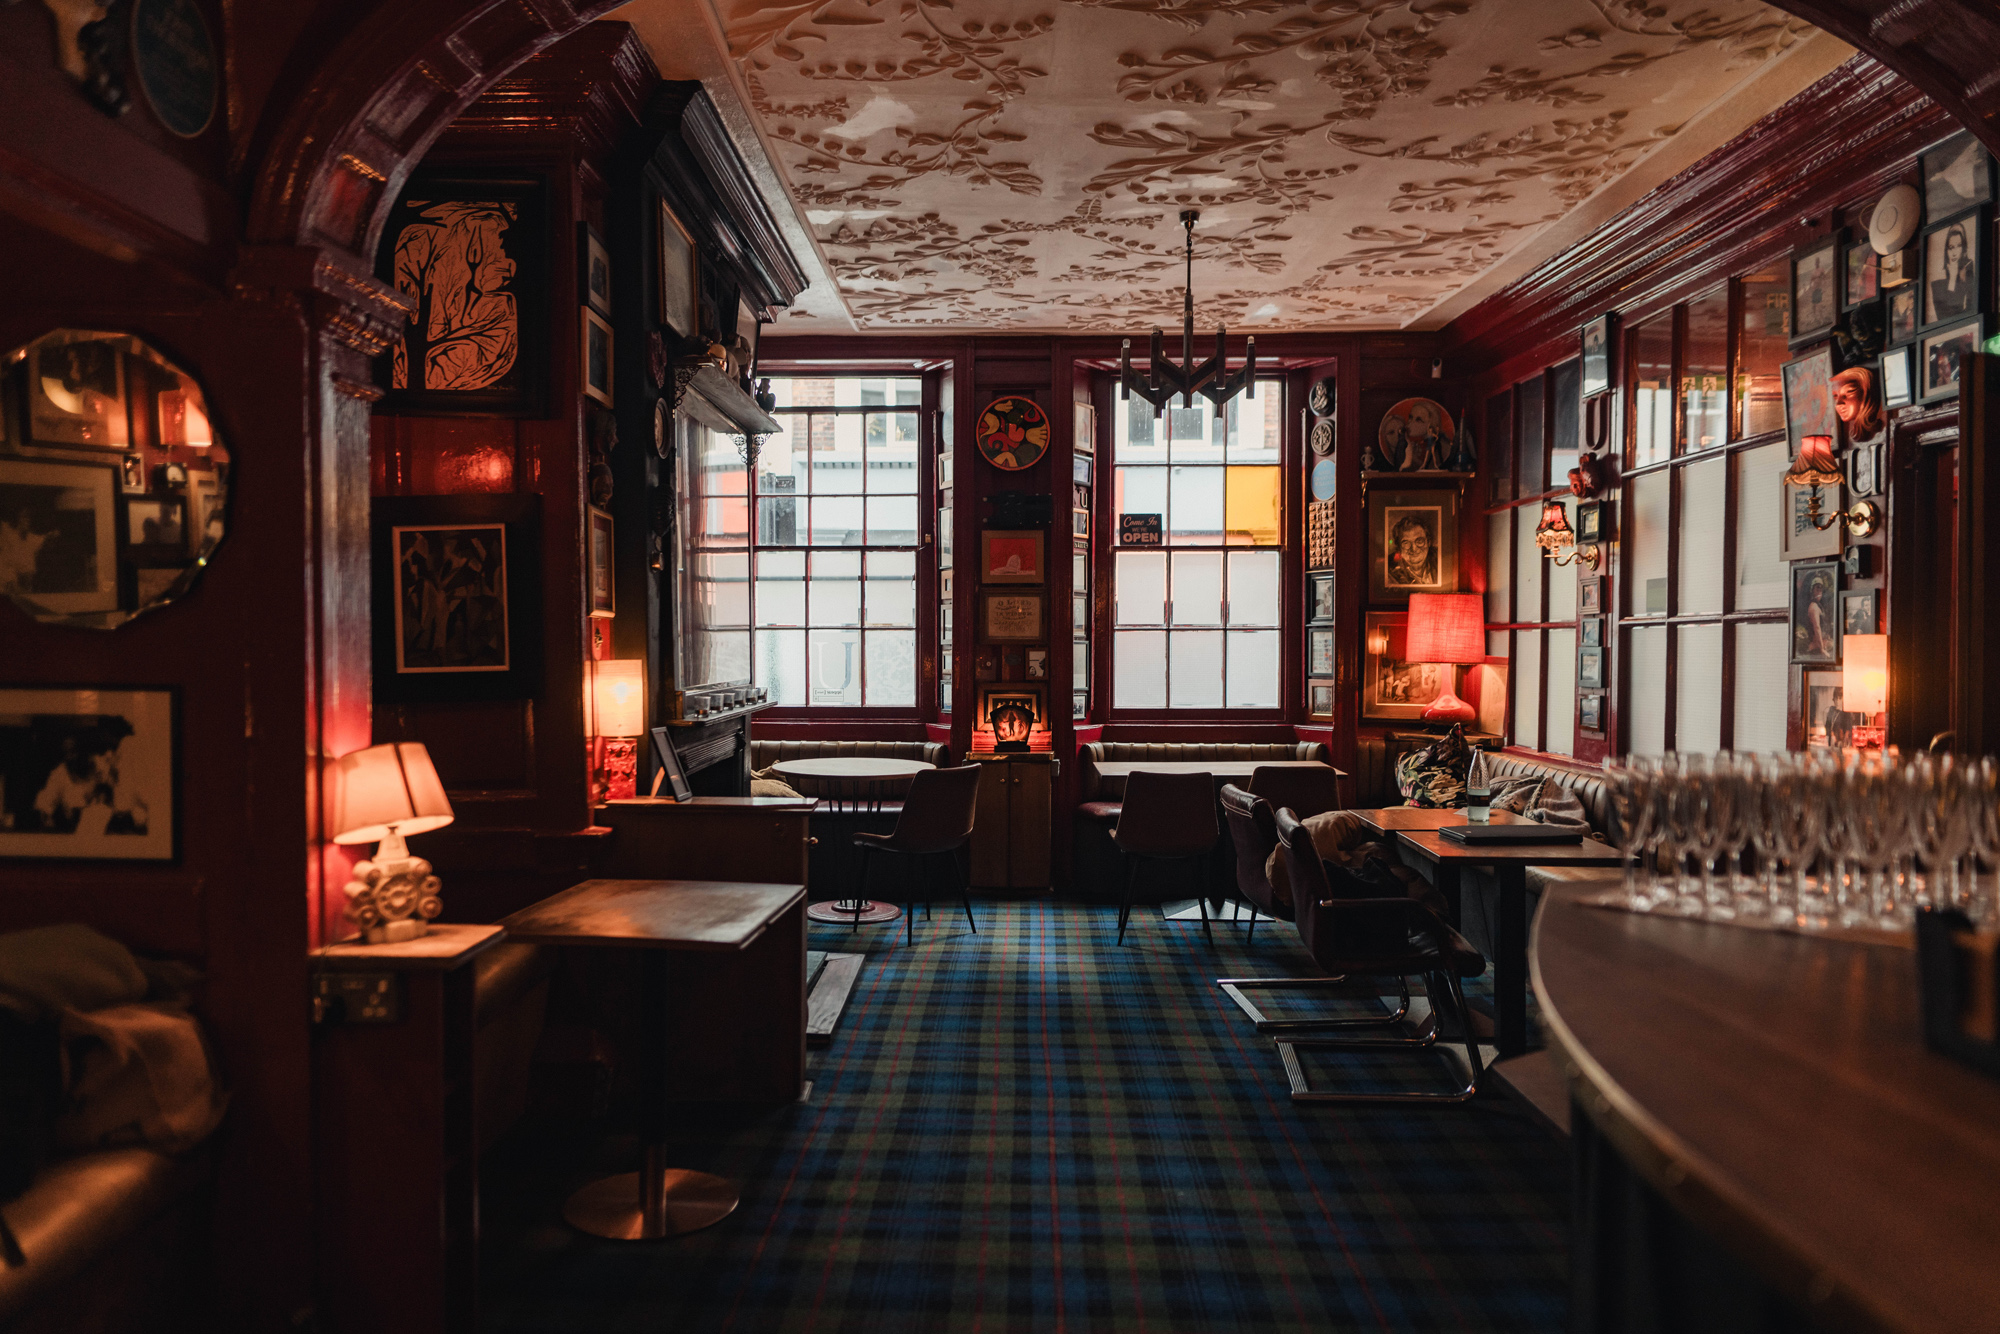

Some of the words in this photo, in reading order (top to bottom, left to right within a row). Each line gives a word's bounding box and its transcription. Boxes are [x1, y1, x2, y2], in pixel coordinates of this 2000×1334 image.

[1123, 516, 1145, 527] Come
[1147, 516, 1158, 526] In
[1122, 532, 1159, 543] OPEN
